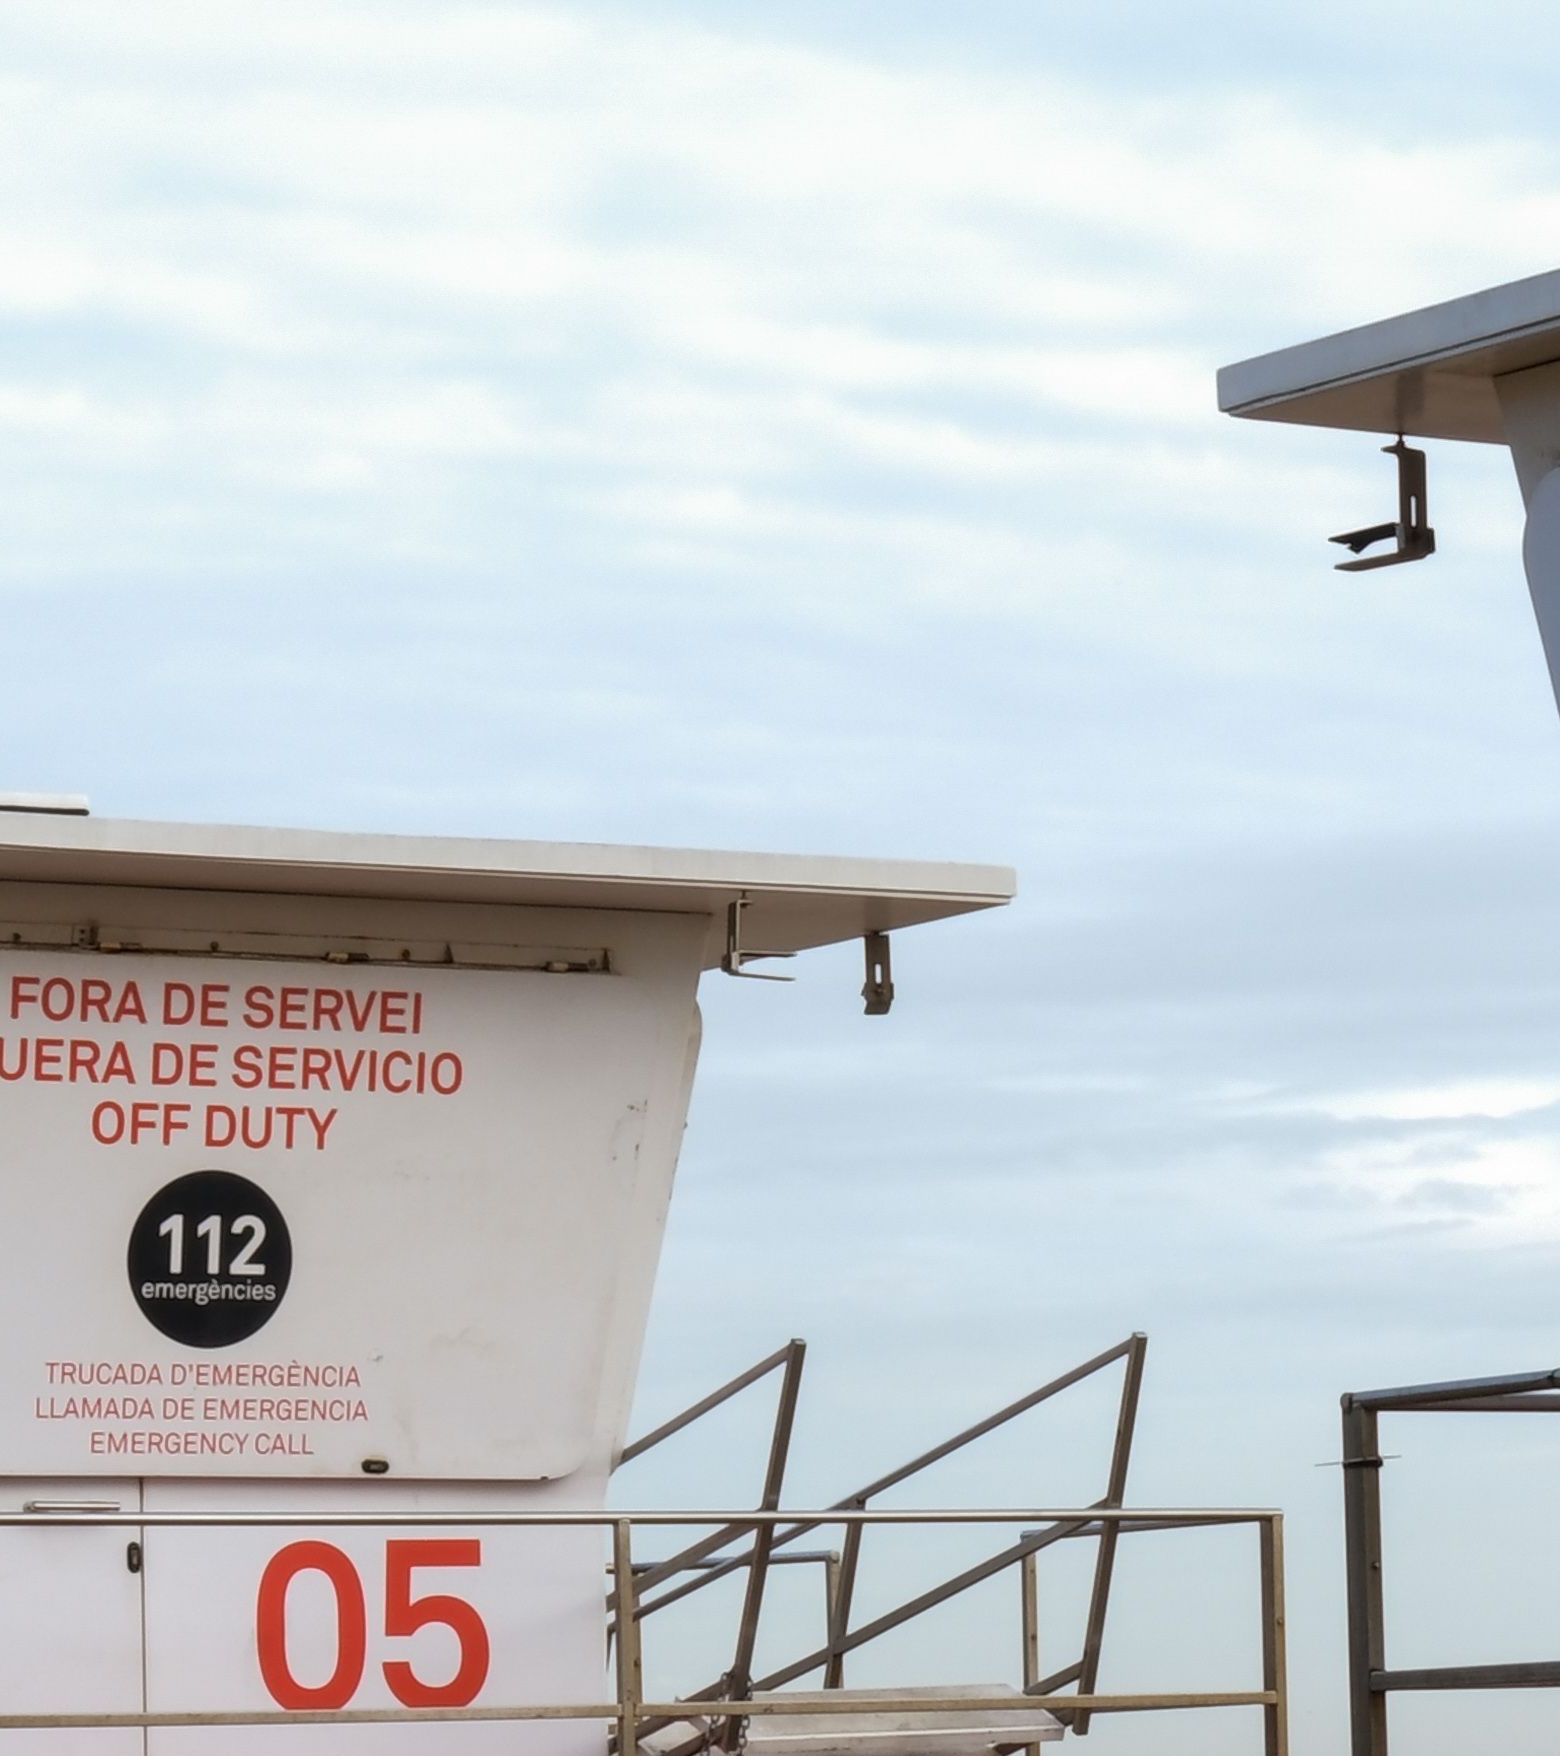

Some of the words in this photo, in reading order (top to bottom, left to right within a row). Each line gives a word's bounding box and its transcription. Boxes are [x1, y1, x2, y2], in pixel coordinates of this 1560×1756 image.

[10, 976, 147, 1025] FORA
[162, 982, 231, 1028] DE
[243, 986, 423, 1035] SERVEI
[151, 1042, 219, 1087] DE
[232, 1045, 463, 1095] SERVICIO
[91, 1100, 191, 1146] OFF
[205, 1105, 338, 1150] DUTY
[158, 1213, 266, 1275] 112
[141, 1279, 277, 1305] emergències
[46, 1362, 163, 1386] TRUCADA
[35, 1396, 155, 1420] LLAMADA
[162, 1397, 195, 1420] DE
[202, 1398, 369, 1422] EMERGENCIA
[90, 1432, 249, 1455] EMERGENCY
[254, 1433, 315, 1456] CALL
[256, 1539, 490, 1710] 05
